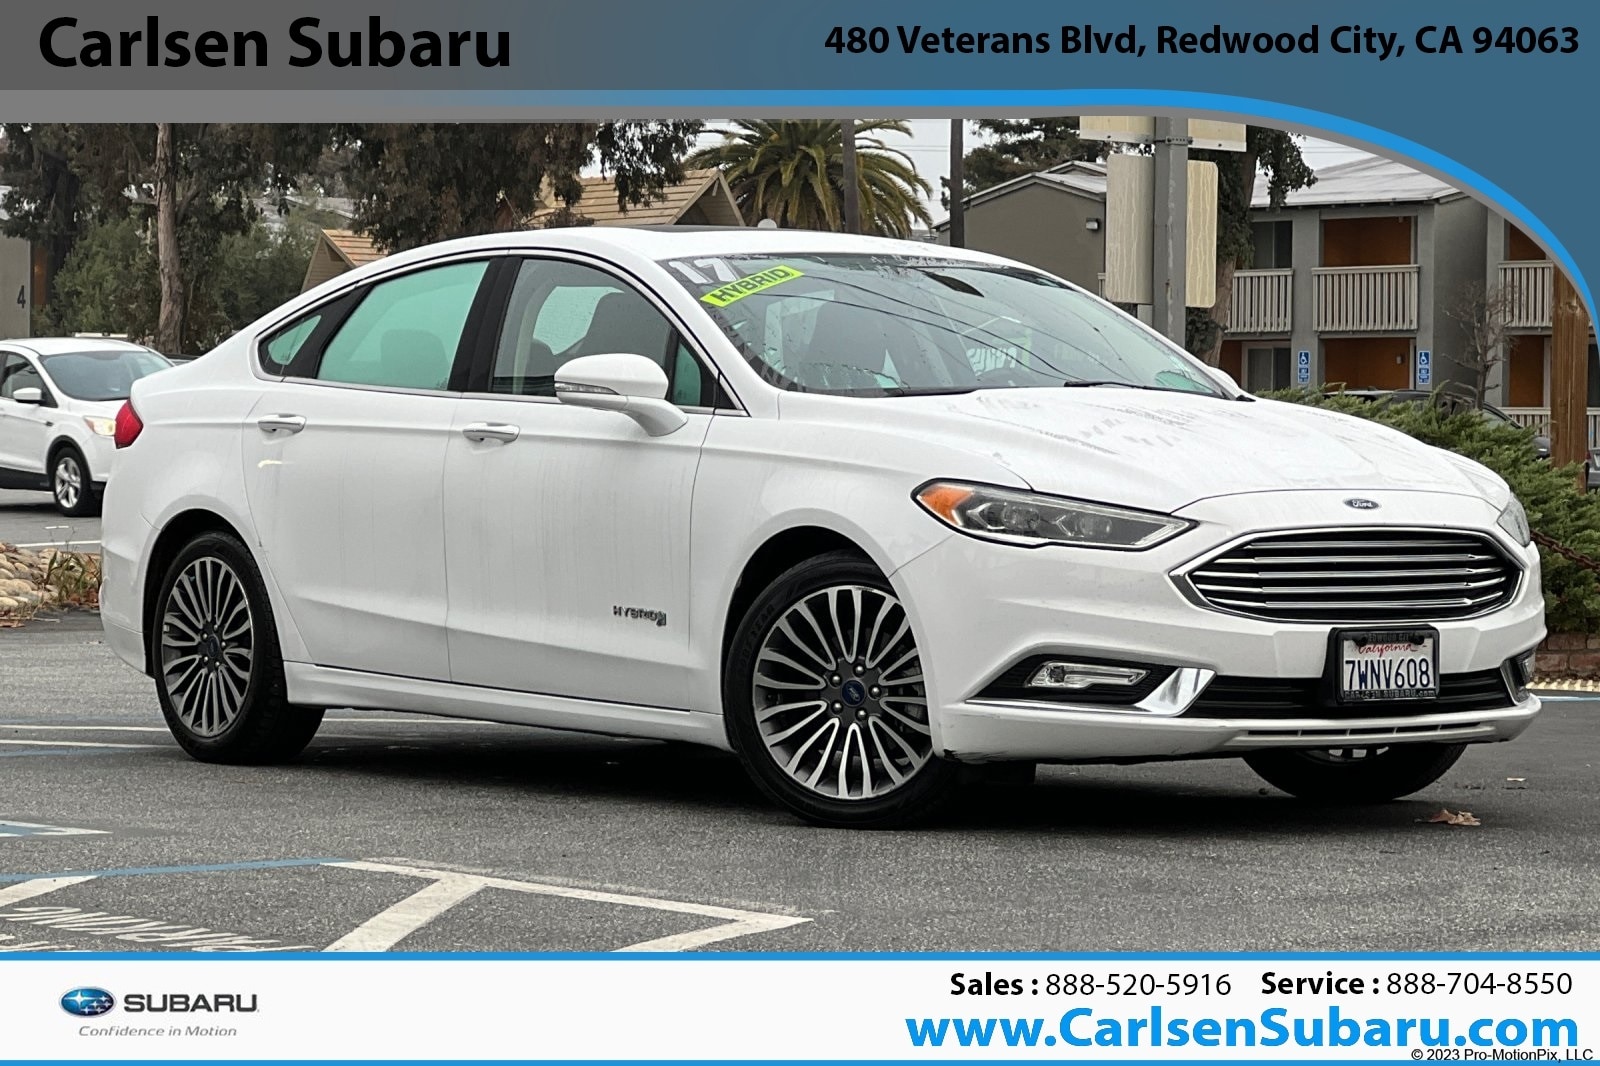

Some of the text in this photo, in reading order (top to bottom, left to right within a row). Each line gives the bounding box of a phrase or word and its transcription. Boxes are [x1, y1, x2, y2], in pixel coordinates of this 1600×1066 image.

[668, 257, 740, 284] 17
[17, 285, 26, 309] 4
[709, 267, 794, 302] HYBRID
[1358, 643, 1418, 658] California
[1345, 658, 1431, 690] 7WNV608
